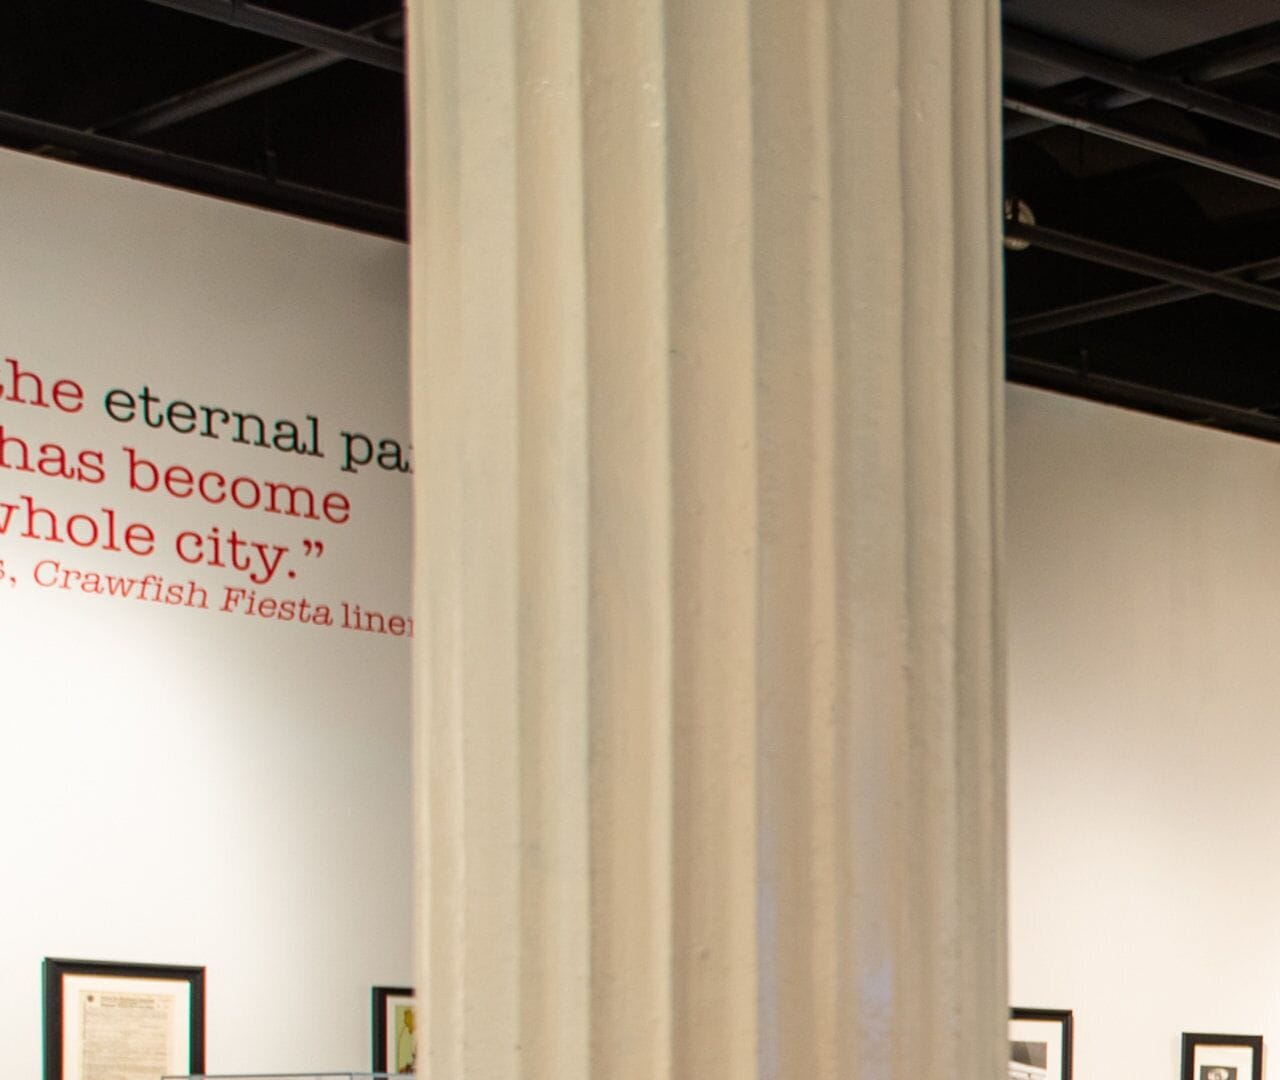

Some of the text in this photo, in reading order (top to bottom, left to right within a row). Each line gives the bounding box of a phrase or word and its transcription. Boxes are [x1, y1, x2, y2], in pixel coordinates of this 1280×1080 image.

[0, 358, 413, 474] he eternal pa
[0, 425, 351, 524] has become
[33, 560, 210, 610] Crawfish
[220, 587, 334, 627] Fiesta
